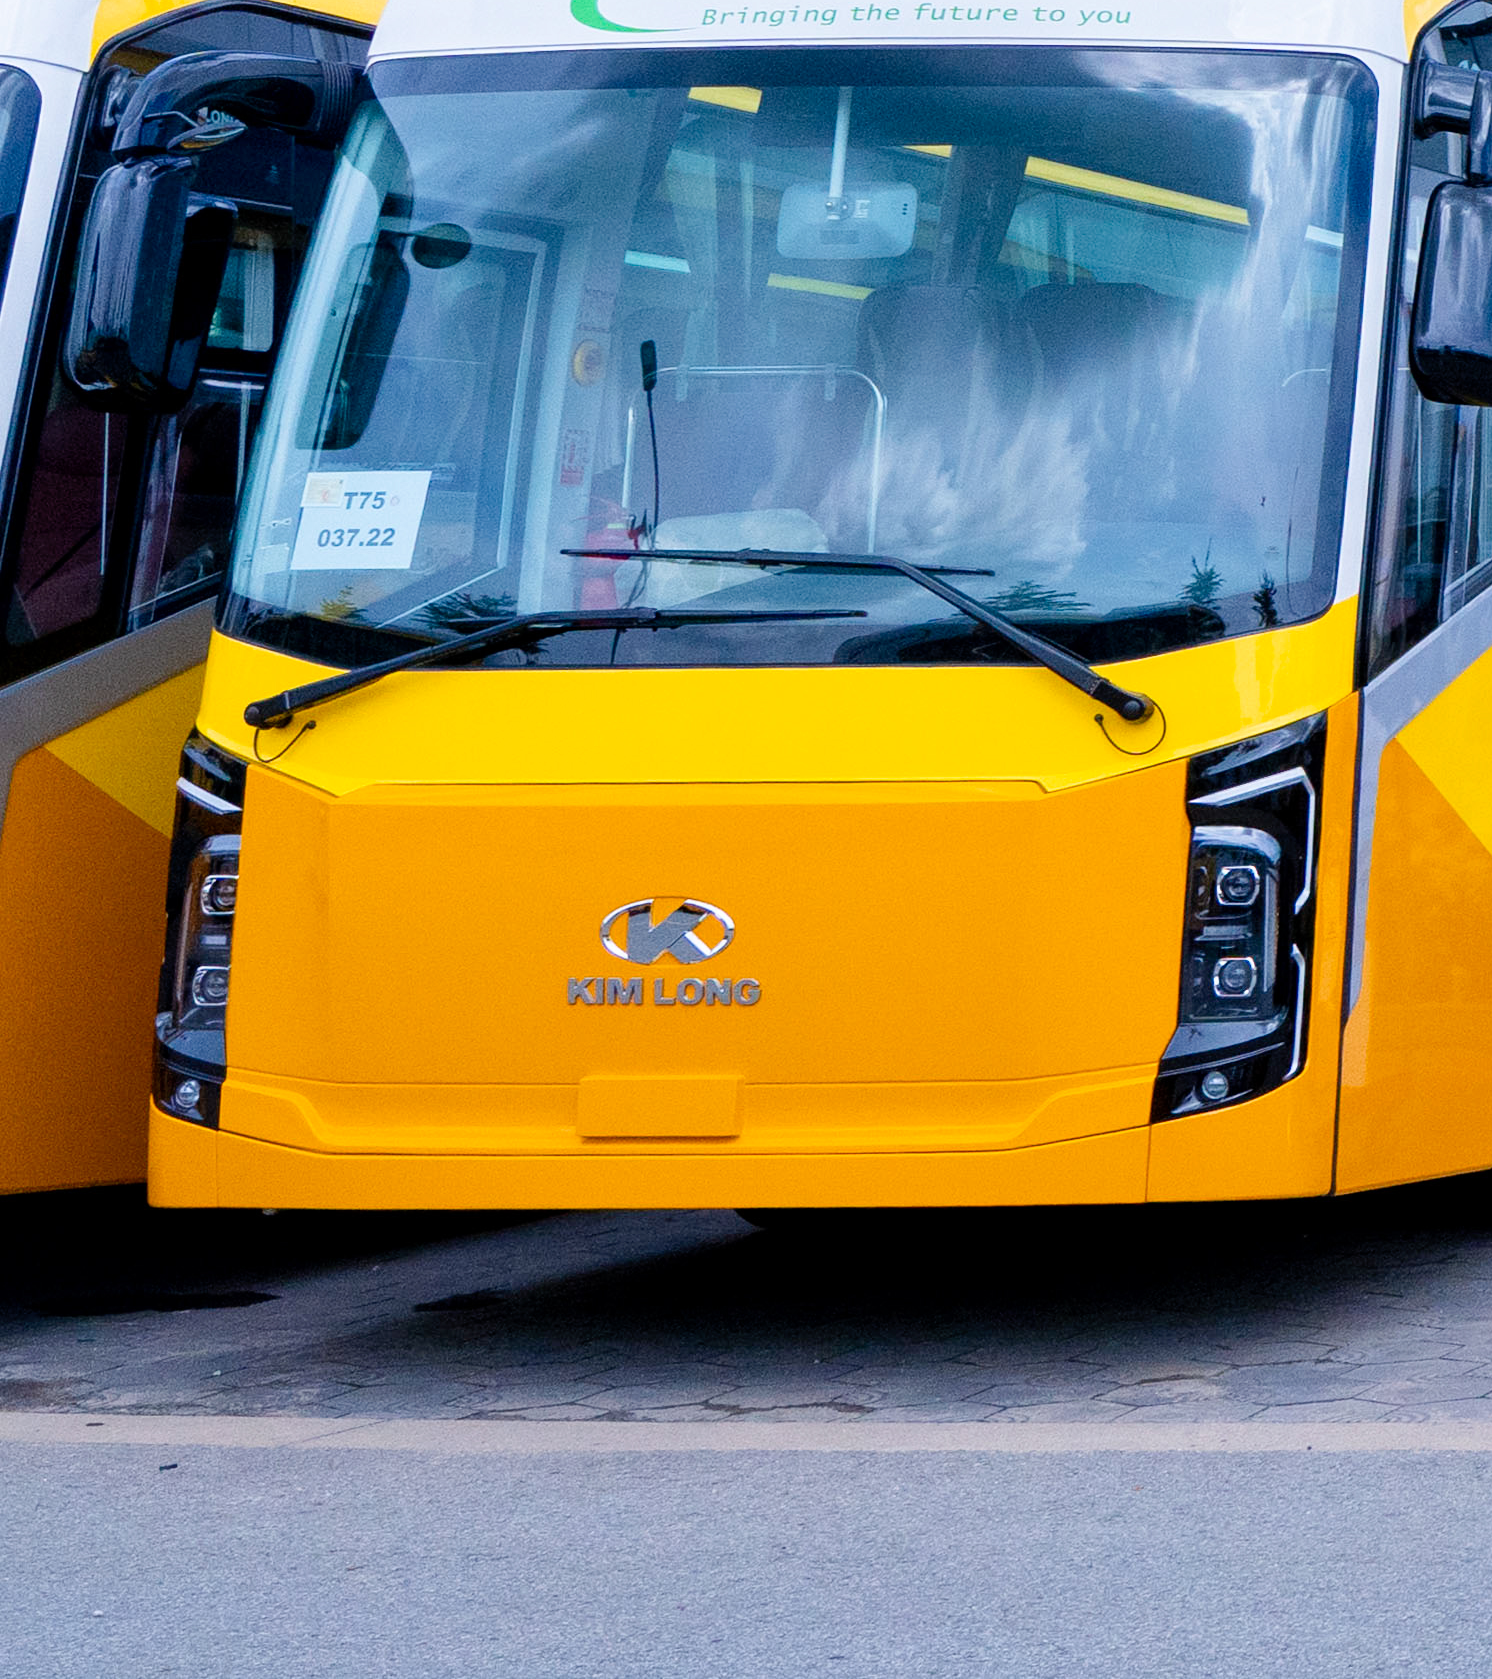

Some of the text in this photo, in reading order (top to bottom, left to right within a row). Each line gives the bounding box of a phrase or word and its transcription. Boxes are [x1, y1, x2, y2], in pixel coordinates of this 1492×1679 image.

[702, 3, 1130, 26] Bringing the future to you
[344, 491, 387, 510] T75
[317, 527, 396, 548] 037.22
[567, 977, 761, 1006] KIM LONG
